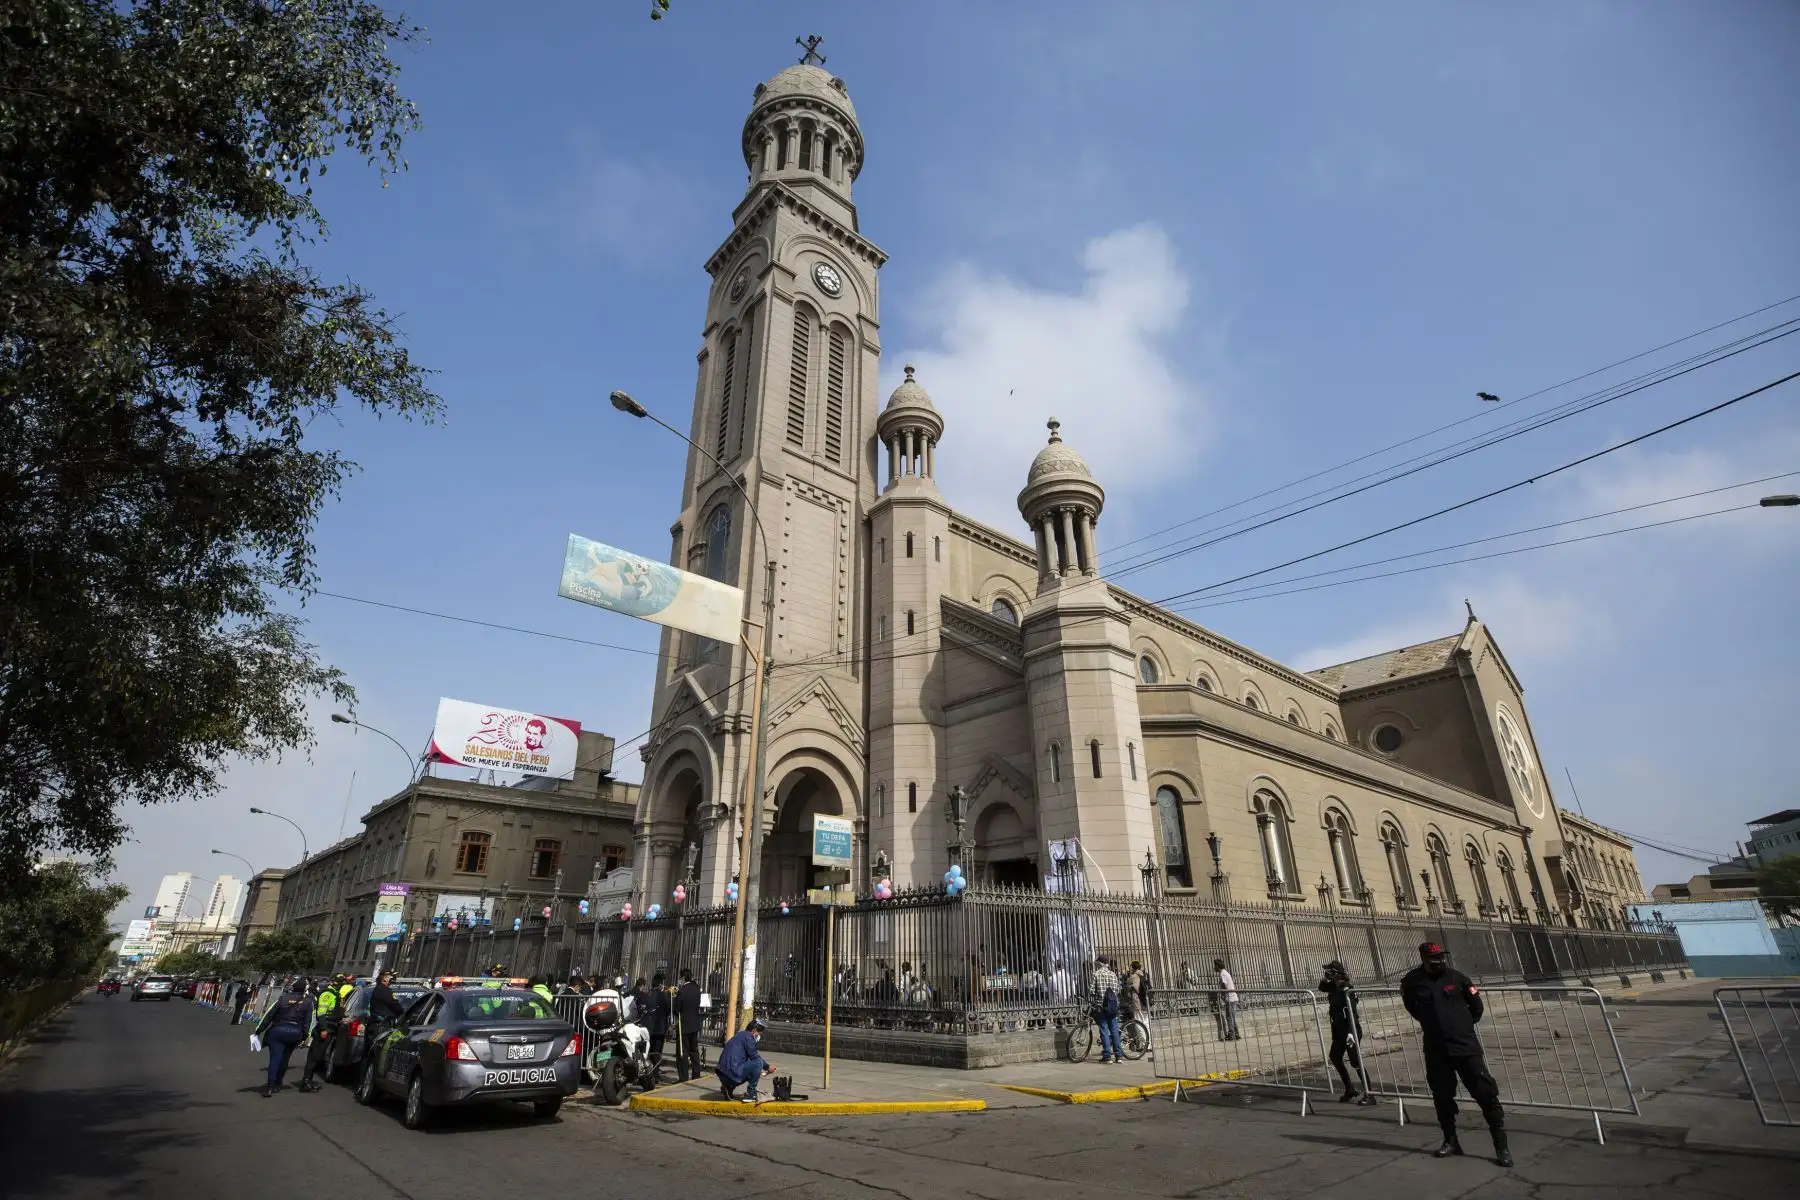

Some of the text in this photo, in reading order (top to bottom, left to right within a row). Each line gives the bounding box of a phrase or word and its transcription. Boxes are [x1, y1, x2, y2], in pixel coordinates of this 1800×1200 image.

[570, 581, 601, 598] Piscina
[464, 744, 550, 766] SALESIANOS DEL PERÚ
[478, 758, 500, 767] MUEVE
[502, 760, 510, 768] LA
[512, 762, 548, 773] ESPERANZA
[484, 1068, 557, 1086] POLICIA
